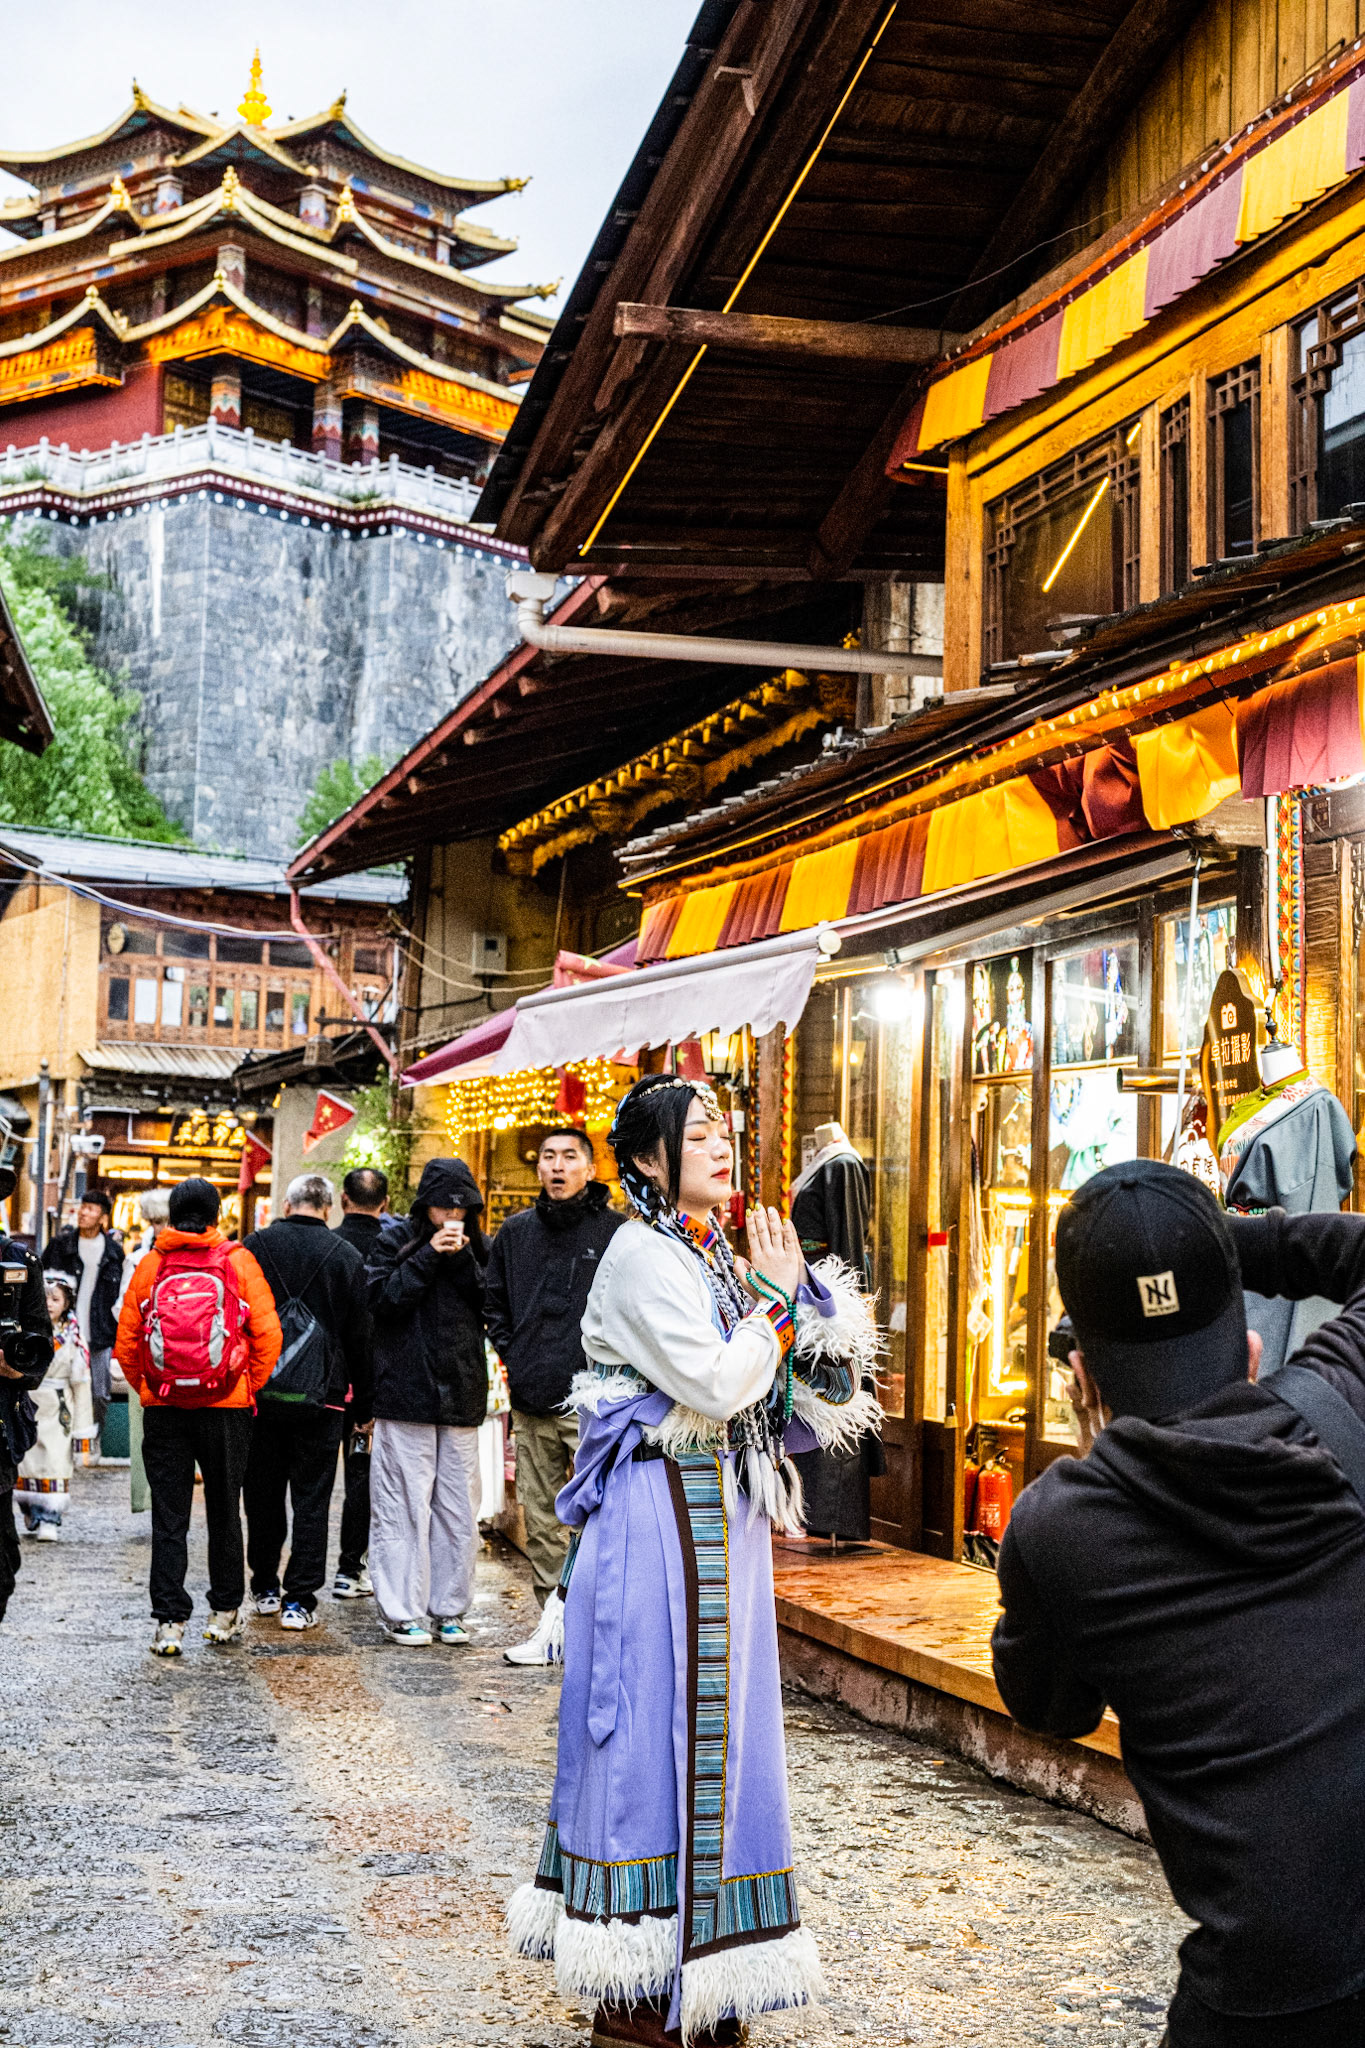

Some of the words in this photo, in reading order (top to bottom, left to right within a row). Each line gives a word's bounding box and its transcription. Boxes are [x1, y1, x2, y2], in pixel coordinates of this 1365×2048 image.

[1211, 1033, 1251, 1068] 卓拉摄影
[1145, 1279, 1172, 1305] NY
